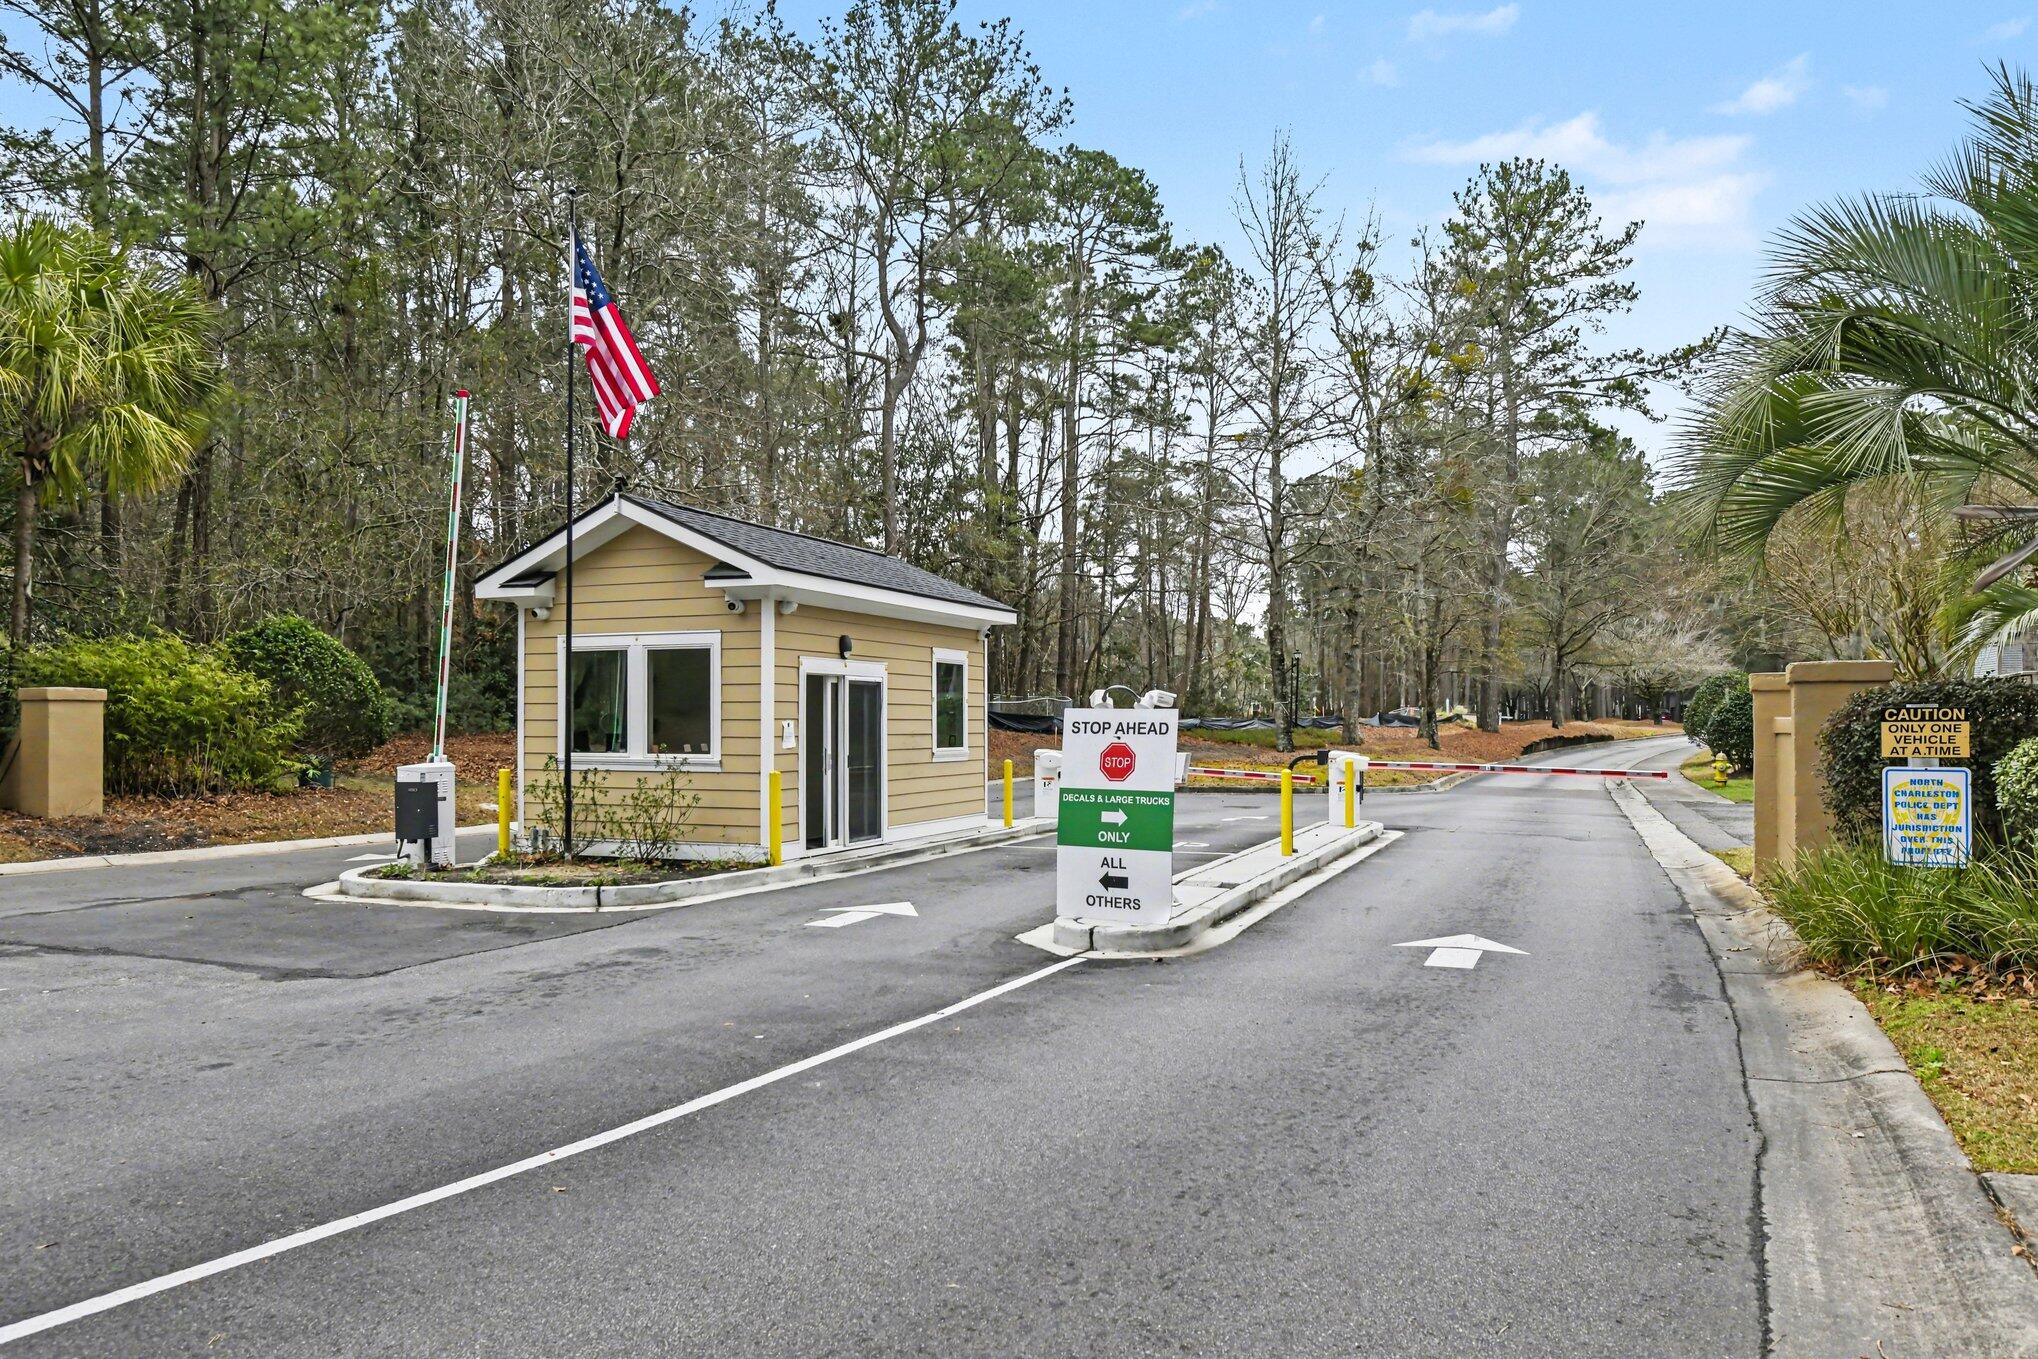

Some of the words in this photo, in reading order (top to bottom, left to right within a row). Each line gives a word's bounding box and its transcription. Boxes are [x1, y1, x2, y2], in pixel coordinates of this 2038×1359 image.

[1884, 708, 1965, 721] CAUTION
[1072, 721, 1111, 736] STOP
[1115, 722, 1169, 736] AHEAD
[1888, 724, 1926, 733] ONLY
[1930, 724, 1962, 732] ONE
[1894, 736, 1956, 744] VEHICLE
[1890, 746, 1908, 756] AT
[1926, 746, 1960, 756] TIME
[1104, 756, 1131, 768] STOP
[1063, 794, 1095, 802] DECALS
[1136, 797, 1170, 805] TRUCKS
[1098, 832, 1130, 842] ONLY
[1100, 858, 1126, 869] ALL
[1086, 896, 1140, 910] OTHERS
